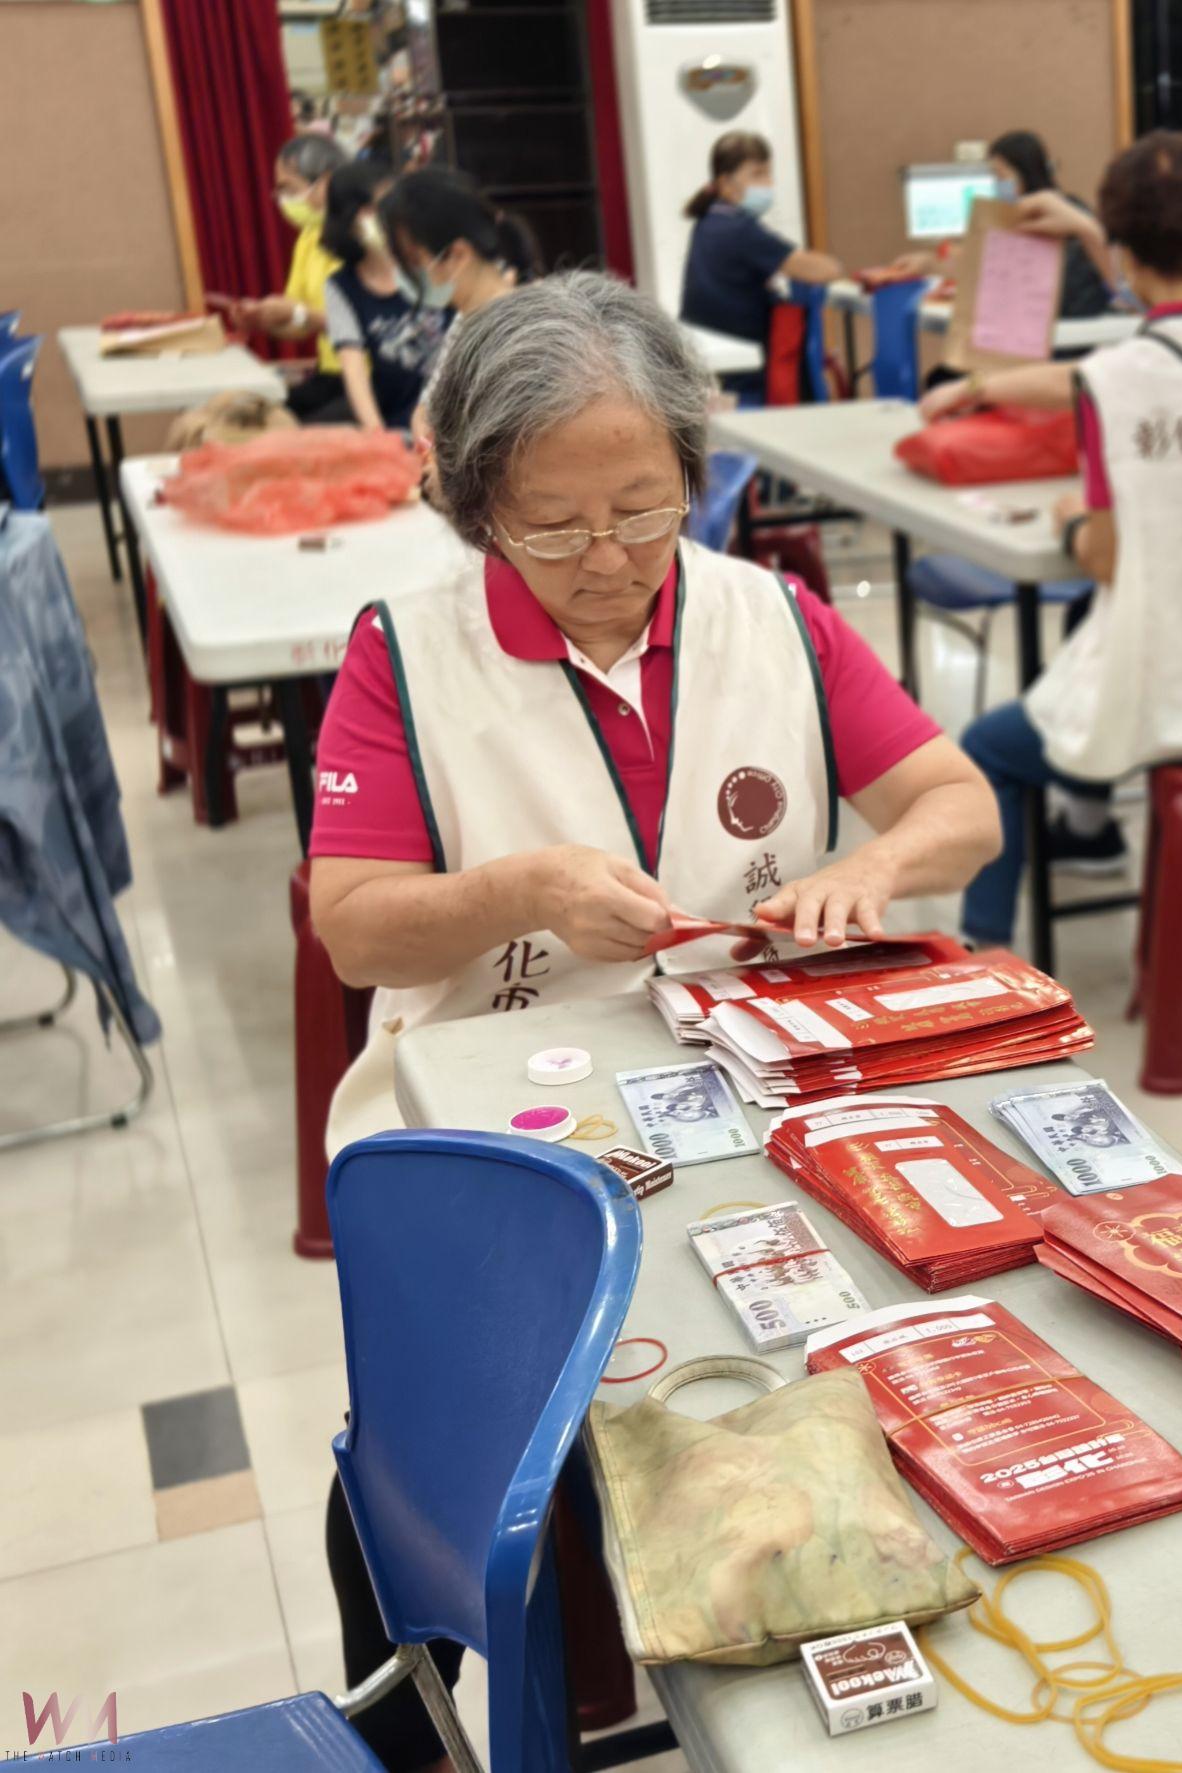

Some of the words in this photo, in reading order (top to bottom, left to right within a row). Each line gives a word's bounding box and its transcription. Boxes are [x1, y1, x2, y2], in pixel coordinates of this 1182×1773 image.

[319, 771, 359, 794] FILA
[649, 1132, 678, 1159] 1000
[728, 1128, 747, 1148] 1000
[1066, 1158, 1103, 1187] 1000
[1144, 1155, 1167, 1174] 1000
[838, 1290, 861, 1310] 500
[749, 1299, 787, 1332] 500
